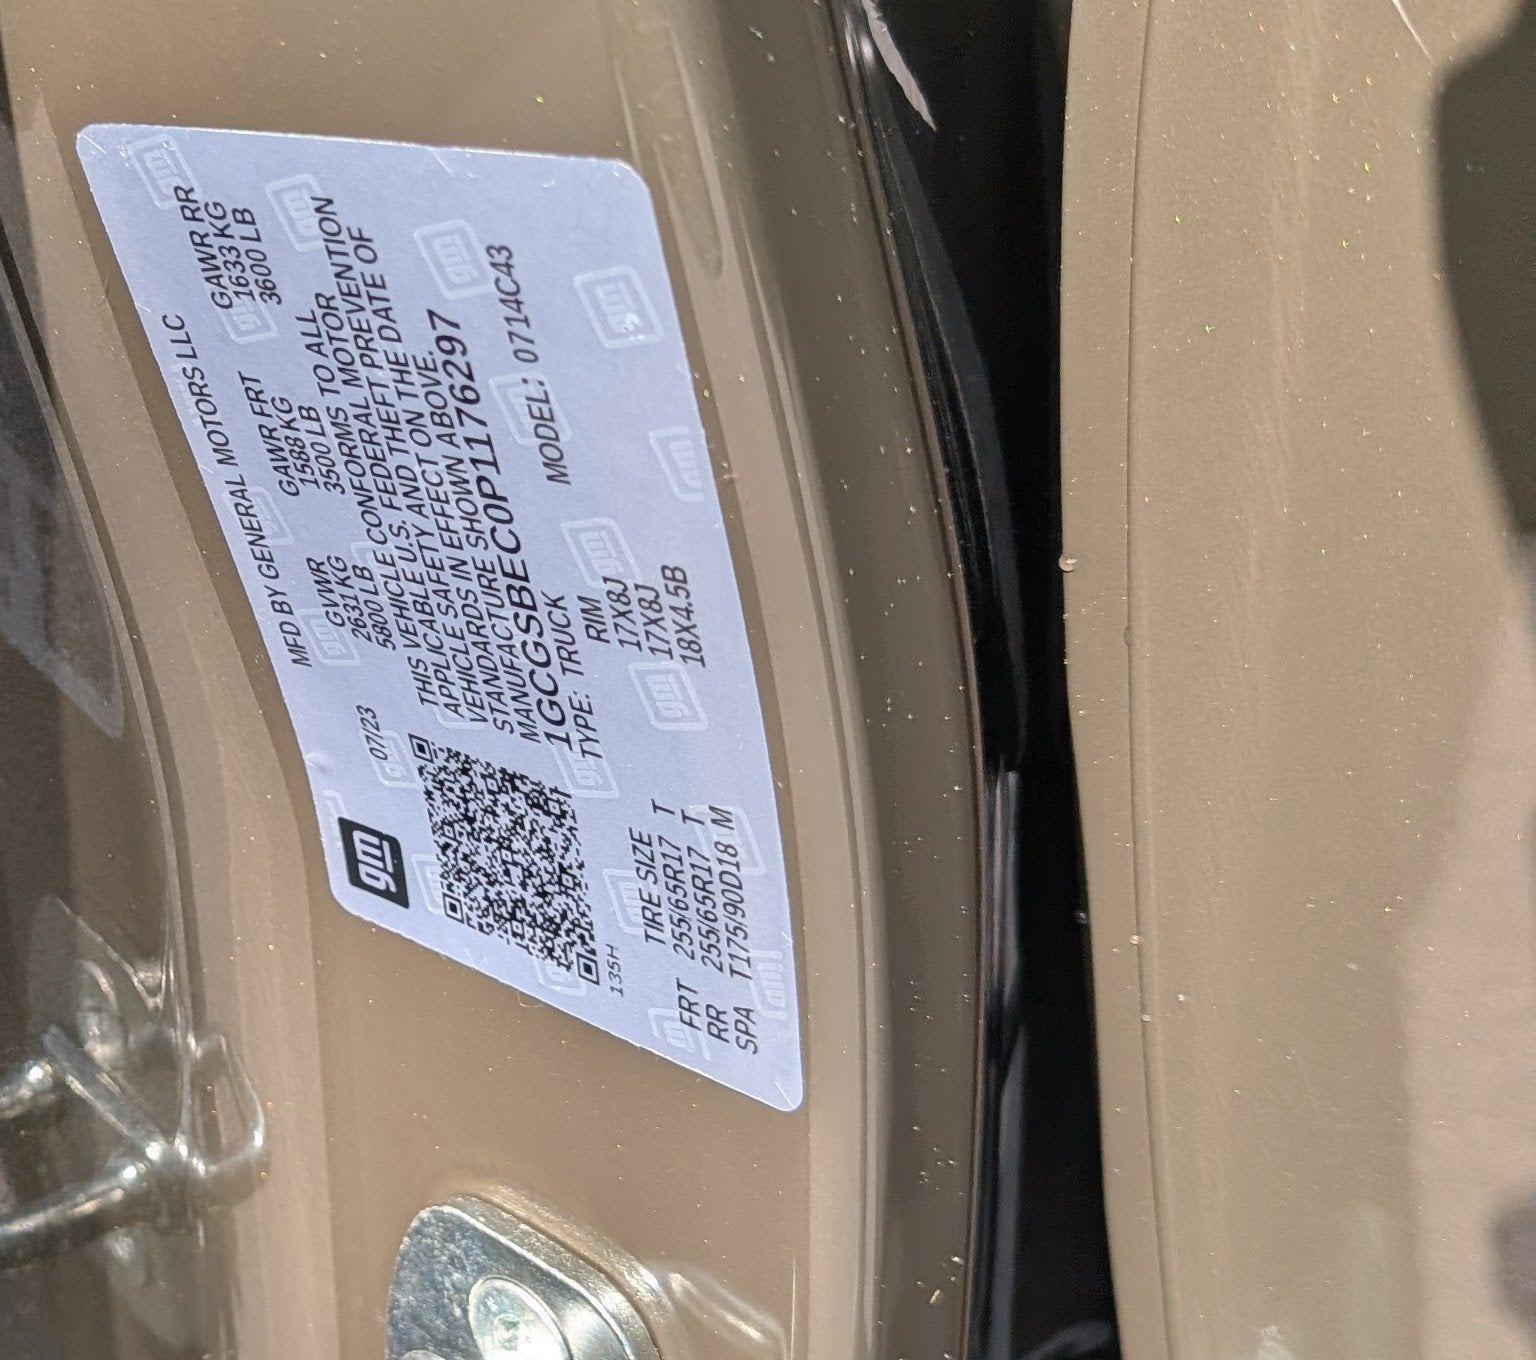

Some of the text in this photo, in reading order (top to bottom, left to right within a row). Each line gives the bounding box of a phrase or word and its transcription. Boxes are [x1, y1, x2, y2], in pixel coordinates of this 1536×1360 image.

[172, 184, 234, 310] GAWR RR
[202, 200, 257, 302] 1633 KG
[229, 206, 283, 306] 3600 LB
[484, 243, 572, 486] MODEL: 0714C43
[236, 369, 301, 497] GAWR FRT
[269, 395, 321, 490] 1588 KG
[296, 403, 346, 496] 3500 LB
[309, 195, 489, 723] VEHICLE SAFETY AND THEFT PREVENTION
[345, 224, 515, 735] STANDARDS IN EFFECT ON THE DATE OF
[160, 313, 313, 668] MFD BY GENERAL MOTORS LLC
[293, 308, 440, 707] THIS VEHICLE CONFORMS TO ALL
[313, 291, 466, 720] APPLICABLE U.S. FEDERAL MOTOR
[424, 307, 574, 753] 1GCGSBEC0P1176297
[304, 556, 346, 628] GVWR
[325, 553, 374, 644] 2631 KG
[410, 349, 542, 744] MANUFACTURE SHOWN ABOVE.
[349, 562, 397, 652] 5800 LB
[575, 593, 611, 644] RIM
[600, 574, 643, 653] 17X8J
[632, 581, 675, 661] 17X8J
[659, 563, 706, 668] 18X4.5B
[539, 589, 604, 760] TYPE: TRUCK
[354, 703, 389, 761] 07/23
[350, 826, 398, 897] gm
[627, 825, 667, 946] TIRE SIZE
[649, 797, 696, 961] 255/65R17 T
[679, 807, 724, 974] 255/65R17 T
[706, 803, 753, 981] T175/90D18 M
[674, 975, 702, 1032] FRT
[704, 1002, 731, 1044] RR
[731, 1005, 759, 1056] SPA
